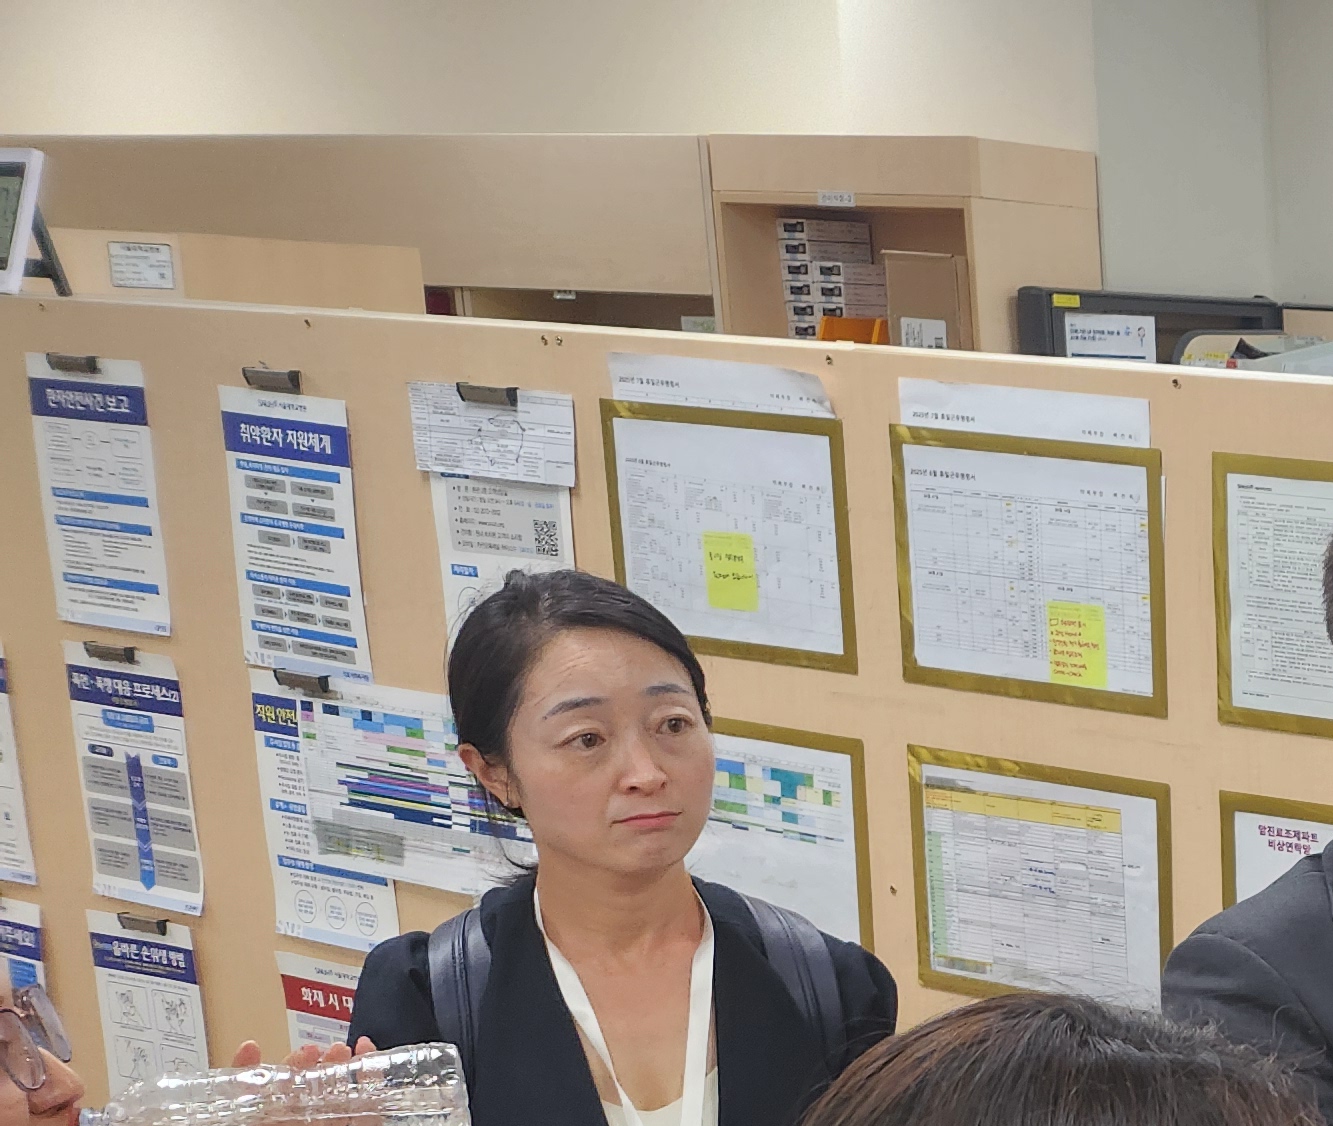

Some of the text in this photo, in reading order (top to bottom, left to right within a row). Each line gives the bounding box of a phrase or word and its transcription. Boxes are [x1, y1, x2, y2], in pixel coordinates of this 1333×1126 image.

[240, 422, 332, 454] 취약환자 지원체계
[256, 704, 298, 727] 직원 안전
[1258, 824, 1319, 843] 암진료조제파트
[1268, 839, 1311, 855] 비상연락망
[301, 986, 325, 1008] 화재
[328, 993, 340, 1010] 시
